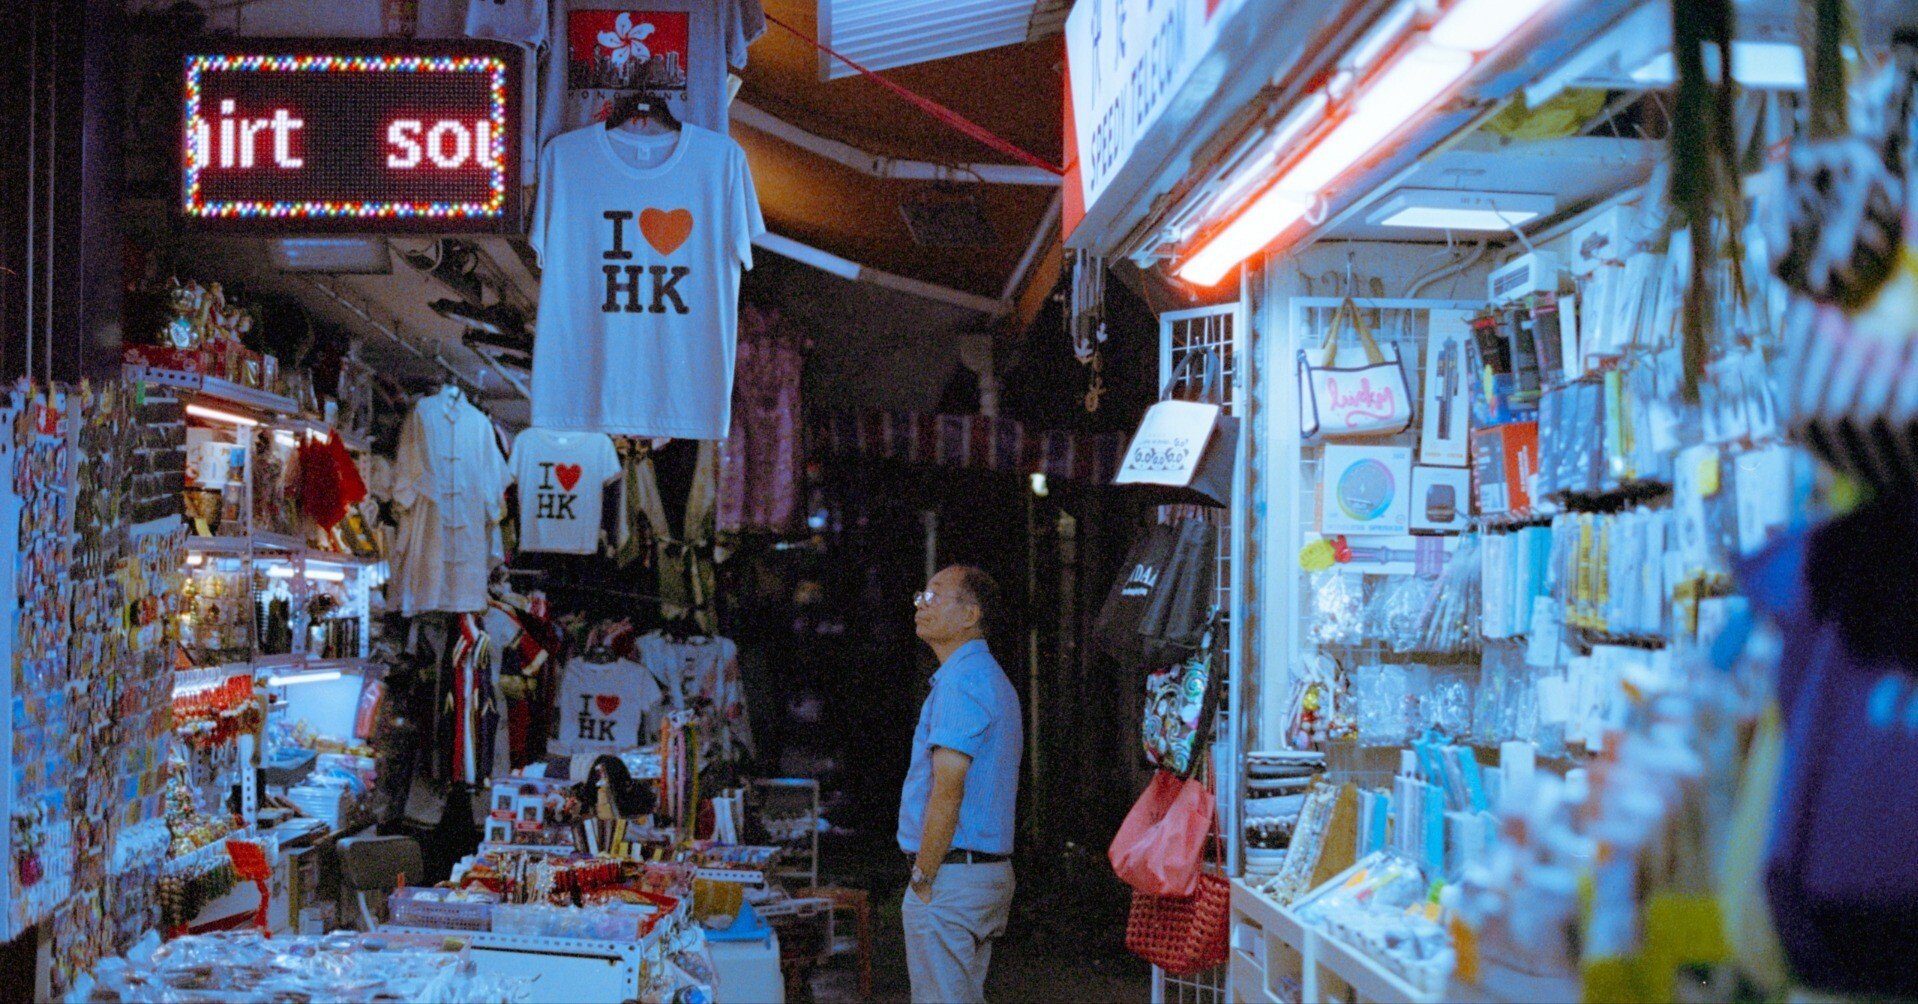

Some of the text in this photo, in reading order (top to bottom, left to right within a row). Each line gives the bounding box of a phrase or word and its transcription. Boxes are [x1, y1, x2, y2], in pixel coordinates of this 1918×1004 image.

[603, 210, 633, 260] I
[601, 264, 690, 314] HK
[538, 462, 554, 490] I
[536, 493, 578, 520] HK
[579, 693, 593, 716] I
[578, 718, 617, 741] HK
